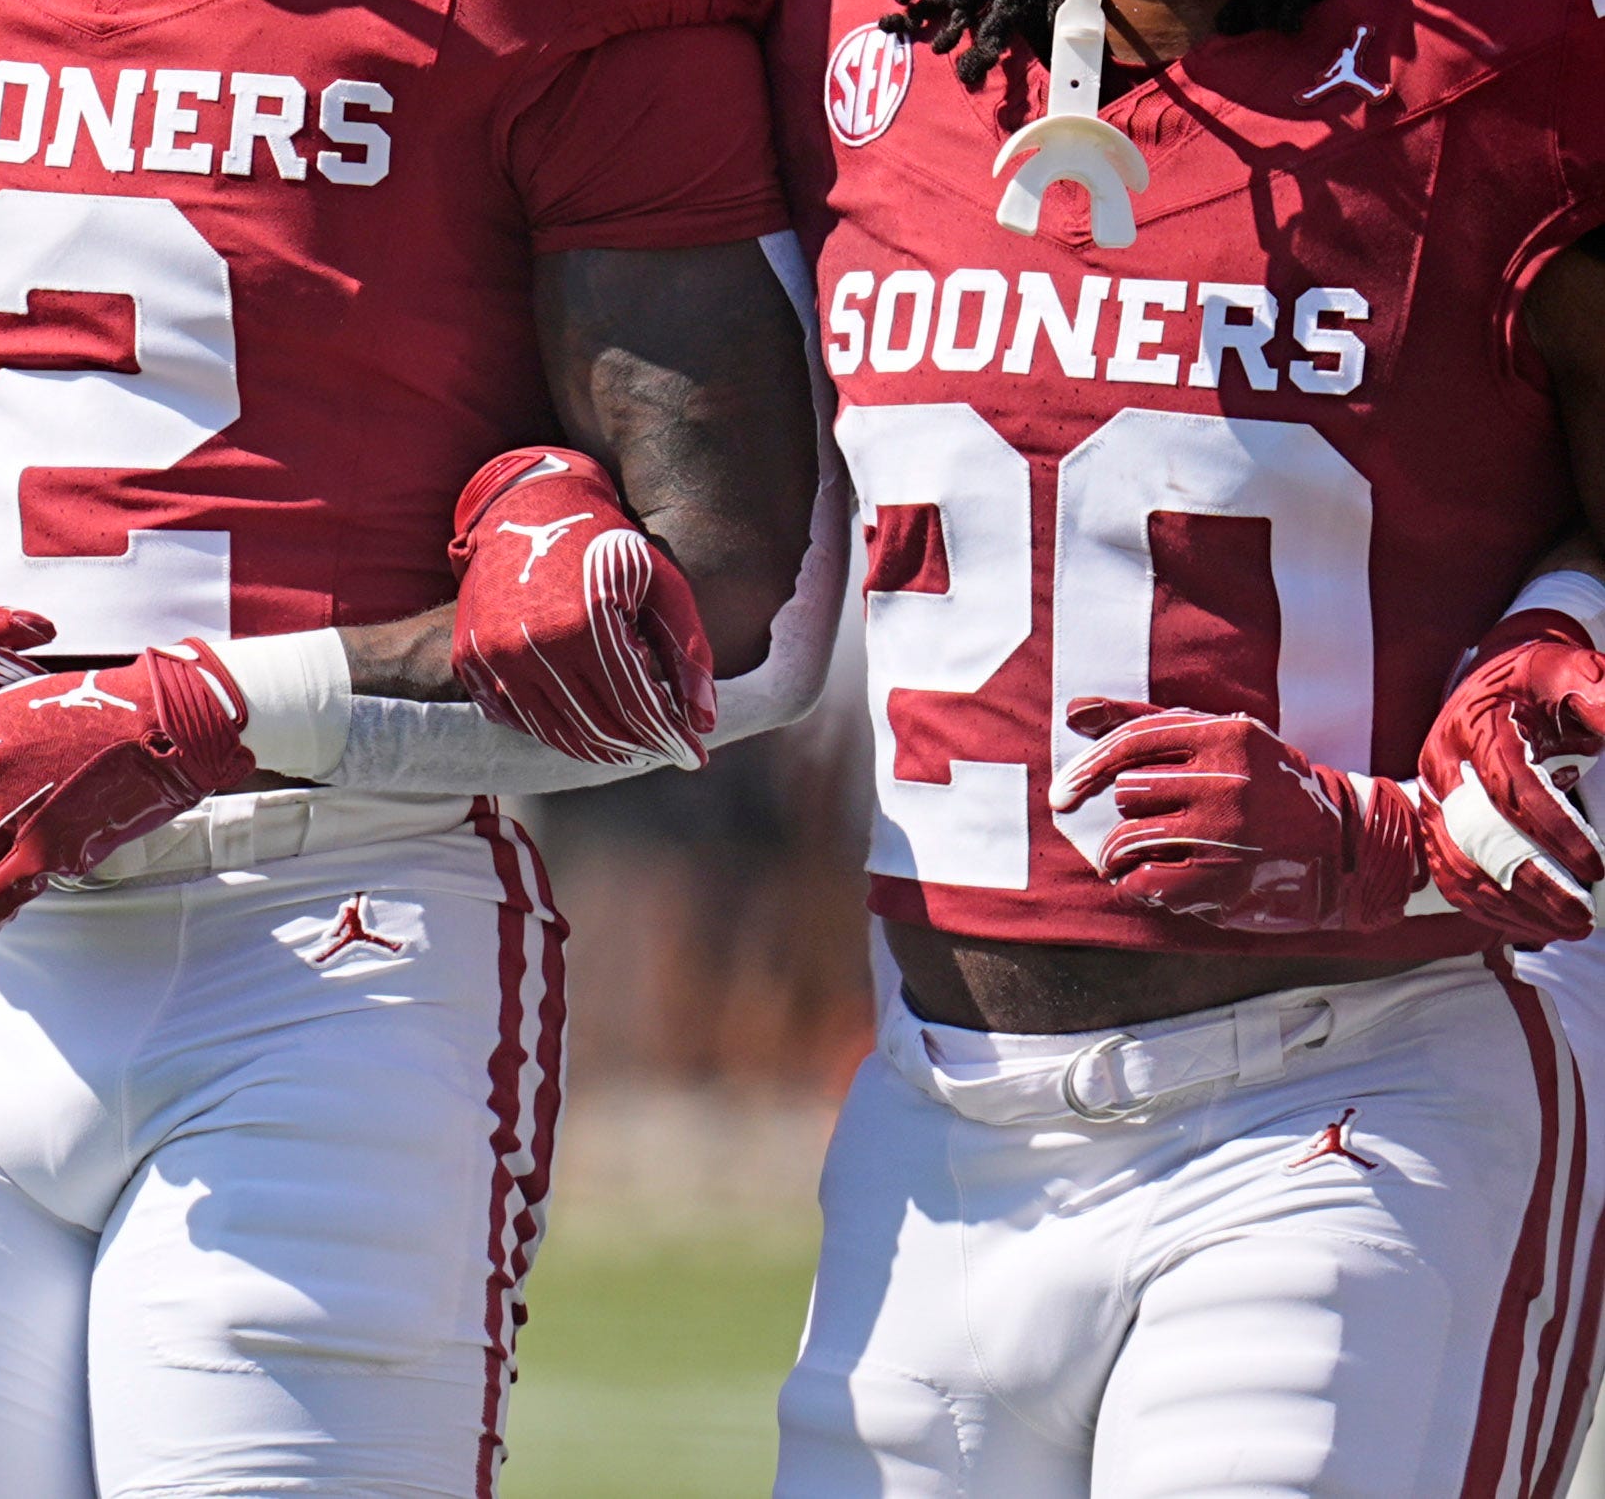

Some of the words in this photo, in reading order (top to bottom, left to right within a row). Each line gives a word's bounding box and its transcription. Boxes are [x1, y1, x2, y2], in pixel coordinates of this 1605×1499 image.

[832, 28, 905, 136] SEC
[827, 268, 1370, 396] SOONERS
[833, 401, 1374, 891] 20
